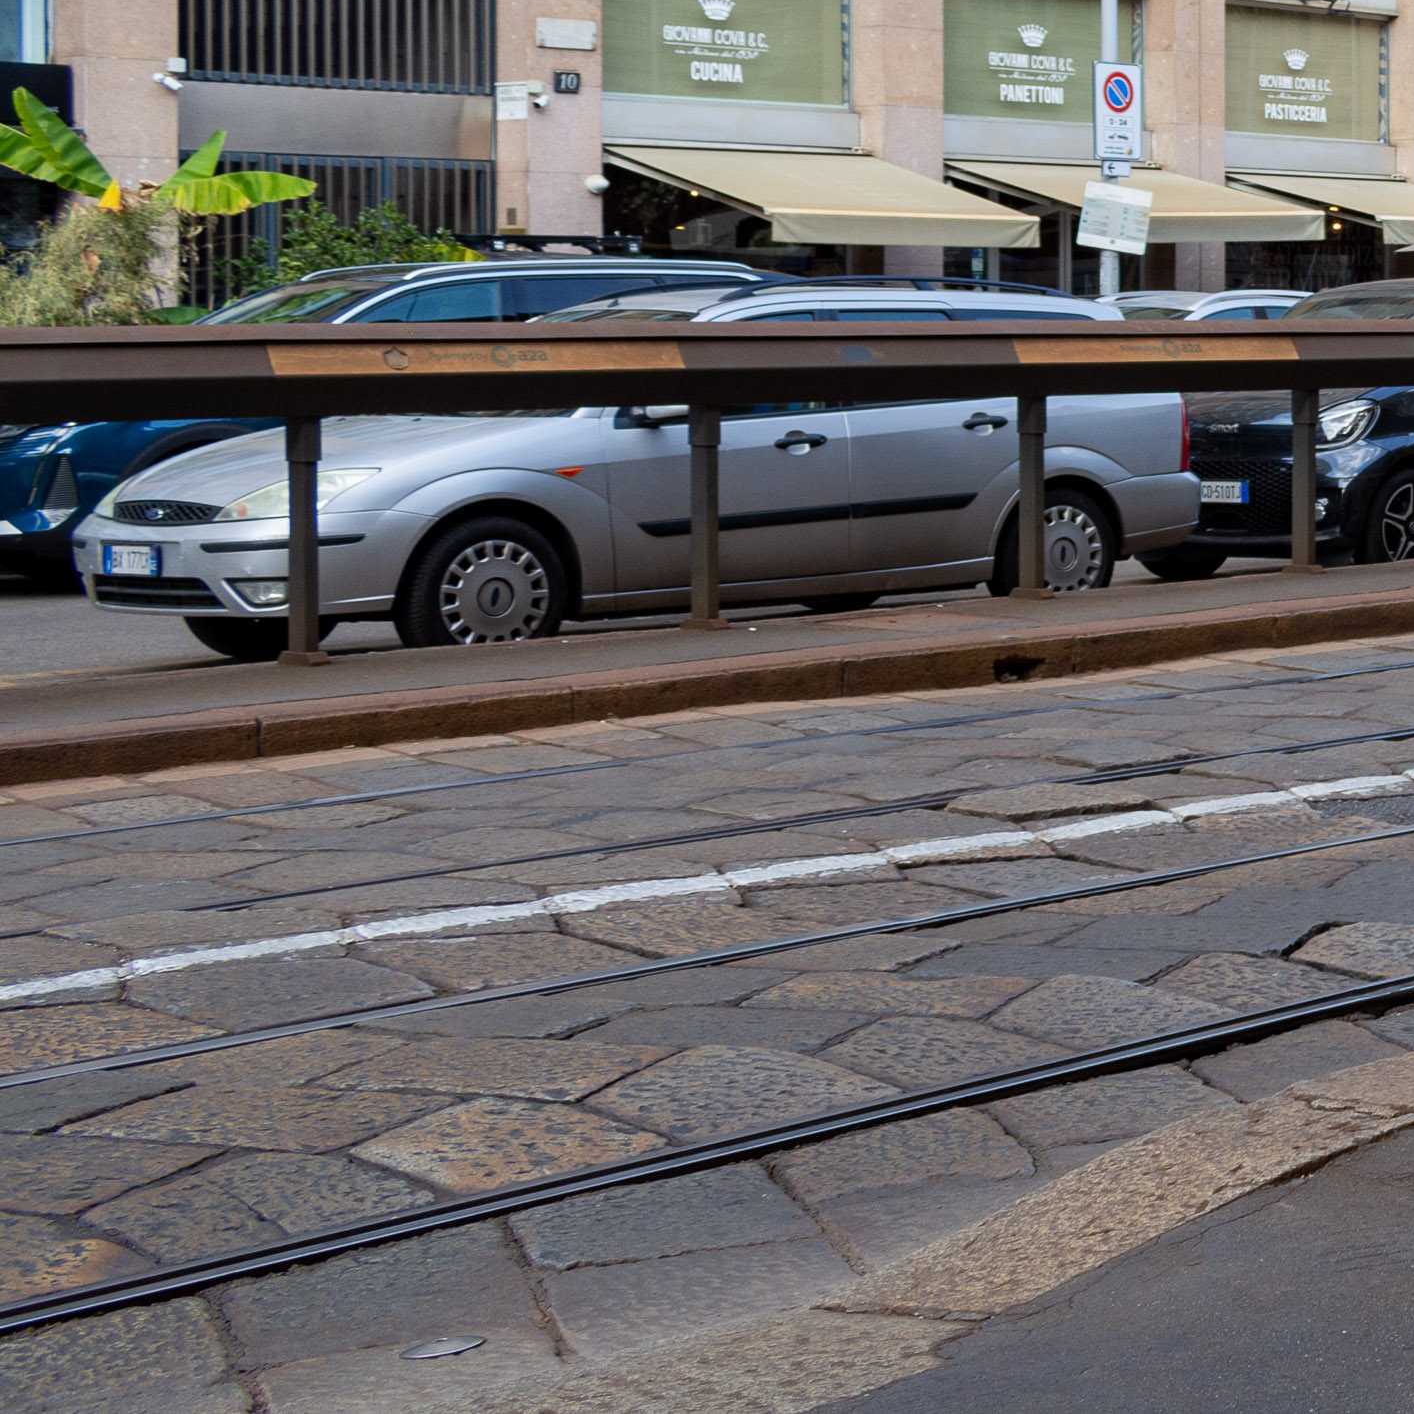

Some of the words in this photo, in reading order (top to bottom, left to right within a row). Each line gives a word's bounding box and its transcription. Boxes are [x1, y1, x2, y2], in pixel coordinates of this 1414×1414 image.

[690, 61, 744, 83] CUCINA
[561, 74, 578, 90] 10
[999, 84, 1064, 105] PANETTONI
[1264, 103, 1328, 122] PASTICCERIA
[1207, 423, 1240, 434] smart
